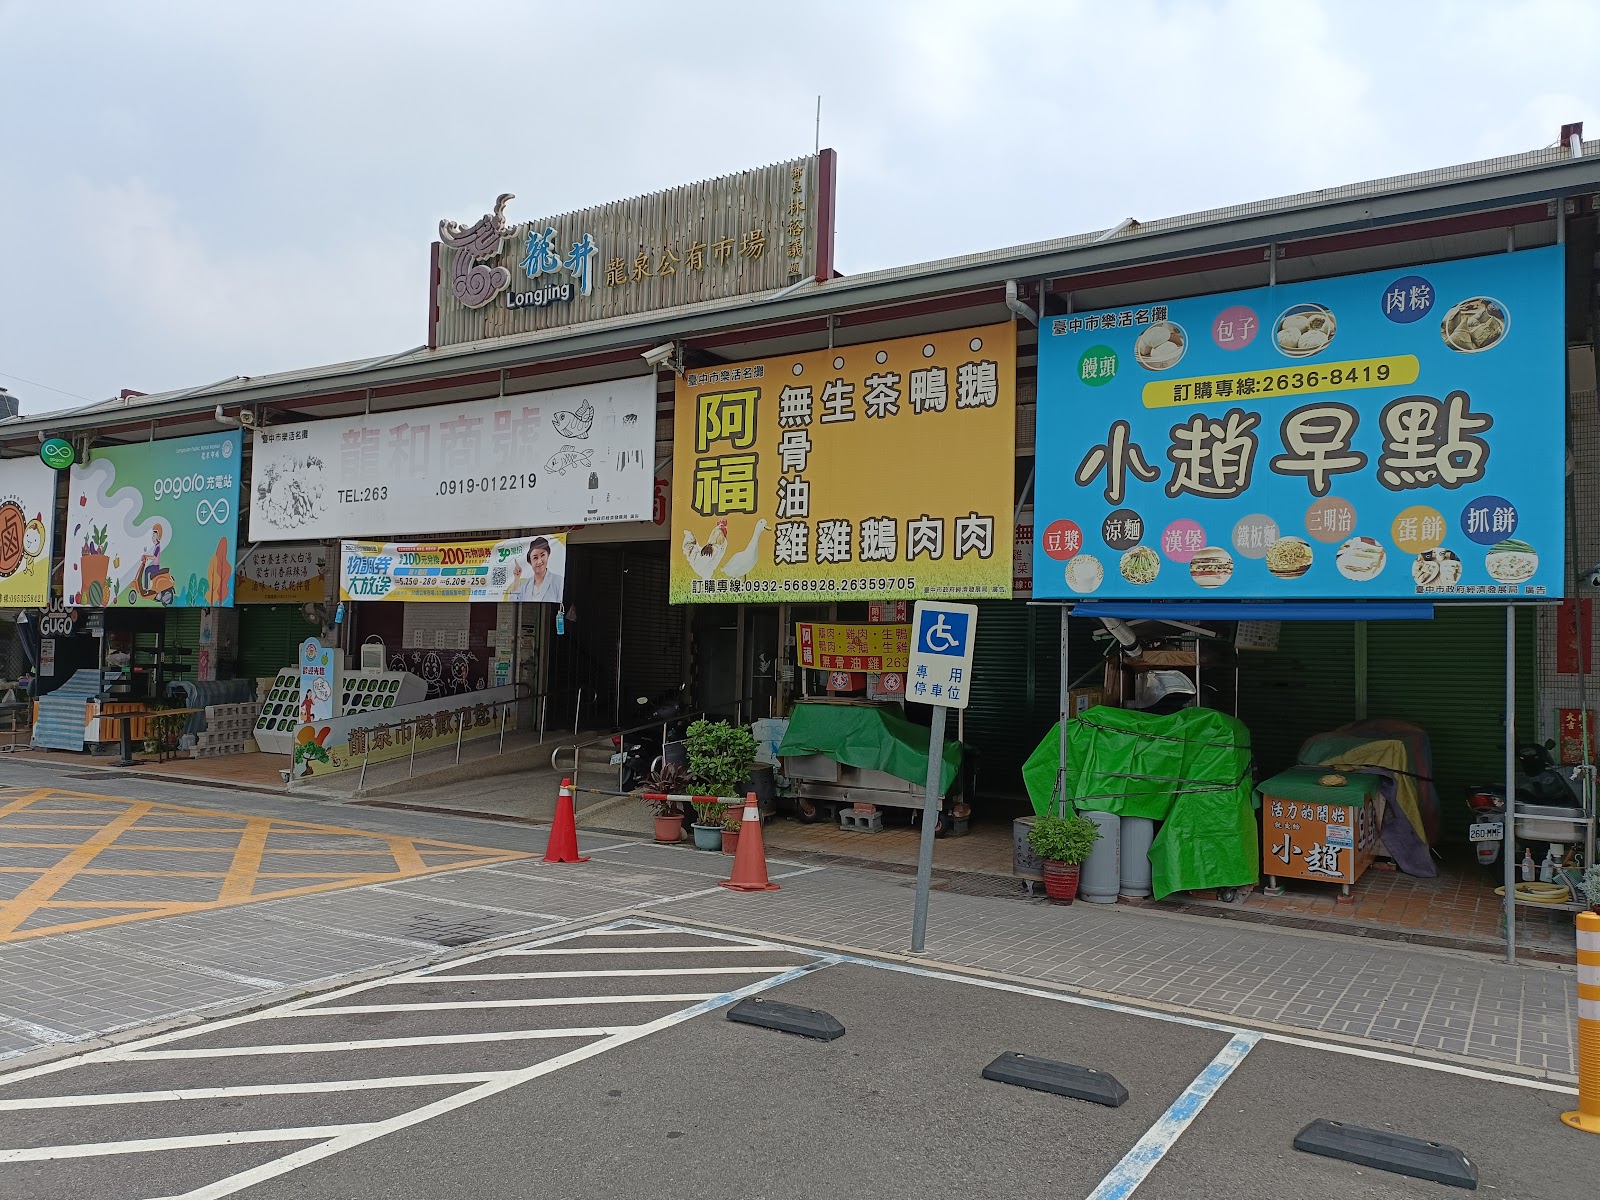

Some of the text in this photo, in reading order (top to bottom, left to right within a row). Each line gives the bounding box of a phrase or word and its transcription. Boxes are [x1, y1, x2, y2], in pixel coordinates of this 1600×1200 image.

[519, 226, 598, 296] 龍井
[604, 229, 766, 289] 龍泉公有市場
[506, 283, 570, 308] Longjing
[1386, 284, 1431, 314] 肉粽
[1052, 306, 1168, 336] 臺中市樂活名攤
[1216, 317, 1256, 342] 包子
[1081, 355, 1116, 379] 饅頭
[694, 388, 761, 515] 阿福
[1077, 392, 1491, 503] 小趙早點
[206, 474, 233, 490] 充電站
[338, 486, 388, 504] TEL:263
[1309, 508, 1352, 532] 三明治
[1397, 516, 1443, 543] 蛋餅
[1467, 506, 1515, 534] 抓餅
[1047, 530, 1080, 552] 豆漿
[1165, 529, 1203, 552] 漢堡
[347, 576, 392, 596] 大放送
[1525, 586, 1547, 595] 廣告
[40, 616, 73, 636] GUGO
[914, 681, 961, 700] 停車位
[1271, 801, 1346, 824] 活力的開始
